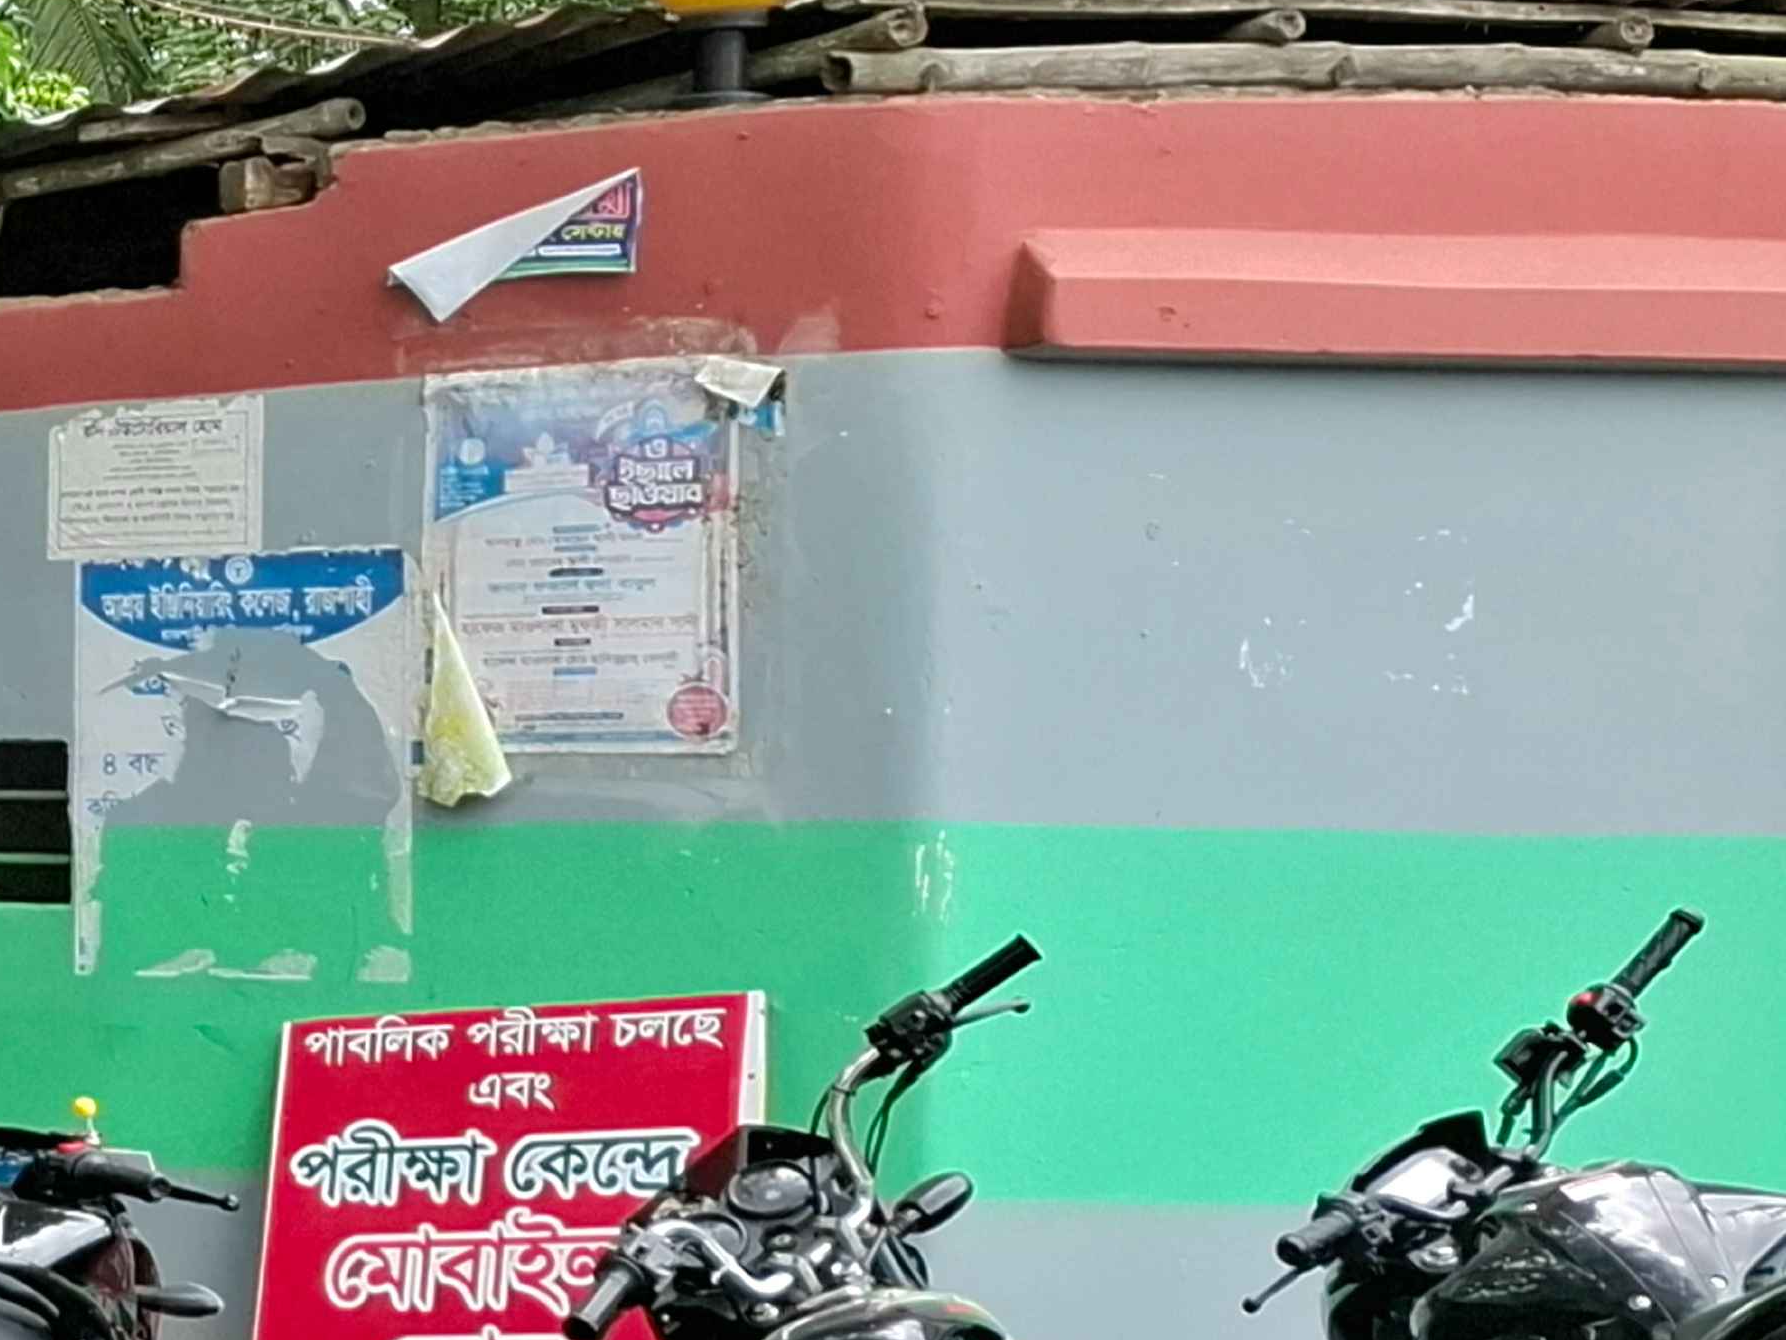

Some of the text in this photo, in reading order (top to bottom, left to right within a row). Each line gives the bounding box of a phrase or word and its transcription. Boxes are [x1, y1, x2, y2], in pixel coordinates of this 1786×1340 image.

[303, 1006, 727, 1069] পাবলিক পরীক্ষা চলছে
[467, 1068, 557, 1112] এবং
[289, 1117, 497, 1209] পরীক্ষা
